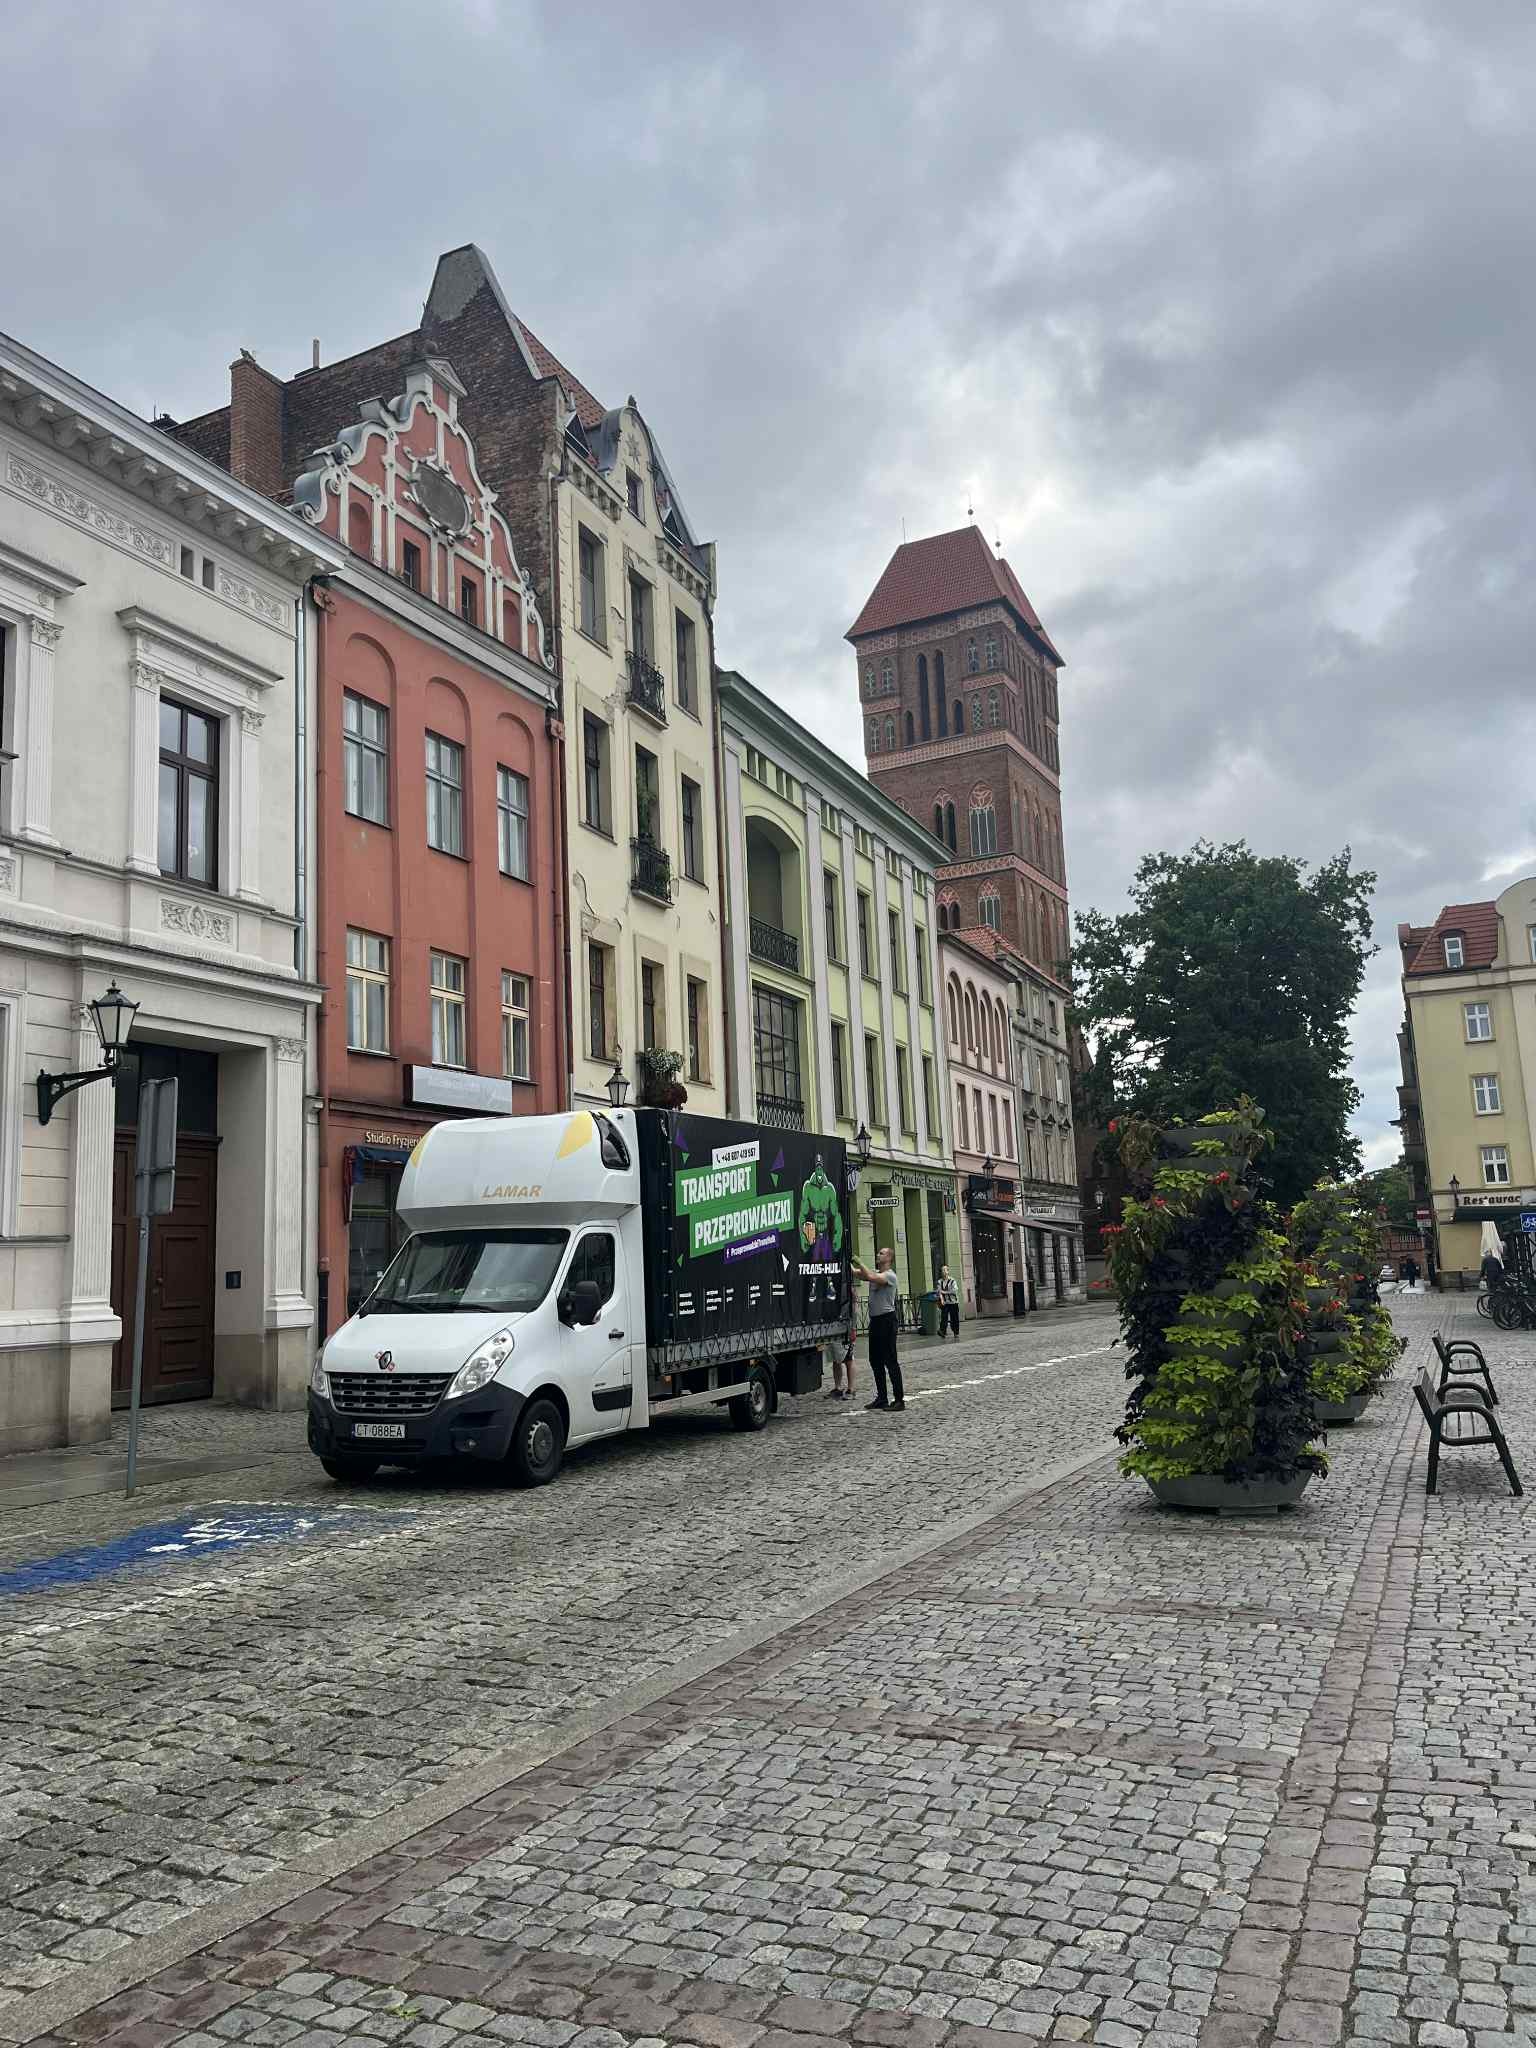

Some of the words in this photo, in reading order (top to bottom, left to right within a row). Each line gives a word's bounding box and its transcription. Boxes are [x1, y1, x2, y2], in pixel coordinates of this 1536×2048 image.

[366, 1131, 392, 1145] Studio
[482, 1185, 544, 1198] LAMAR
[681, 1166, 752, 1206] TRANSPORT
[694, 1199, 792, 1249] PRZEPROWADZKI
[357, 1424, 368, 1437] CT
[371, 1425, 403, 1438] 088EA
